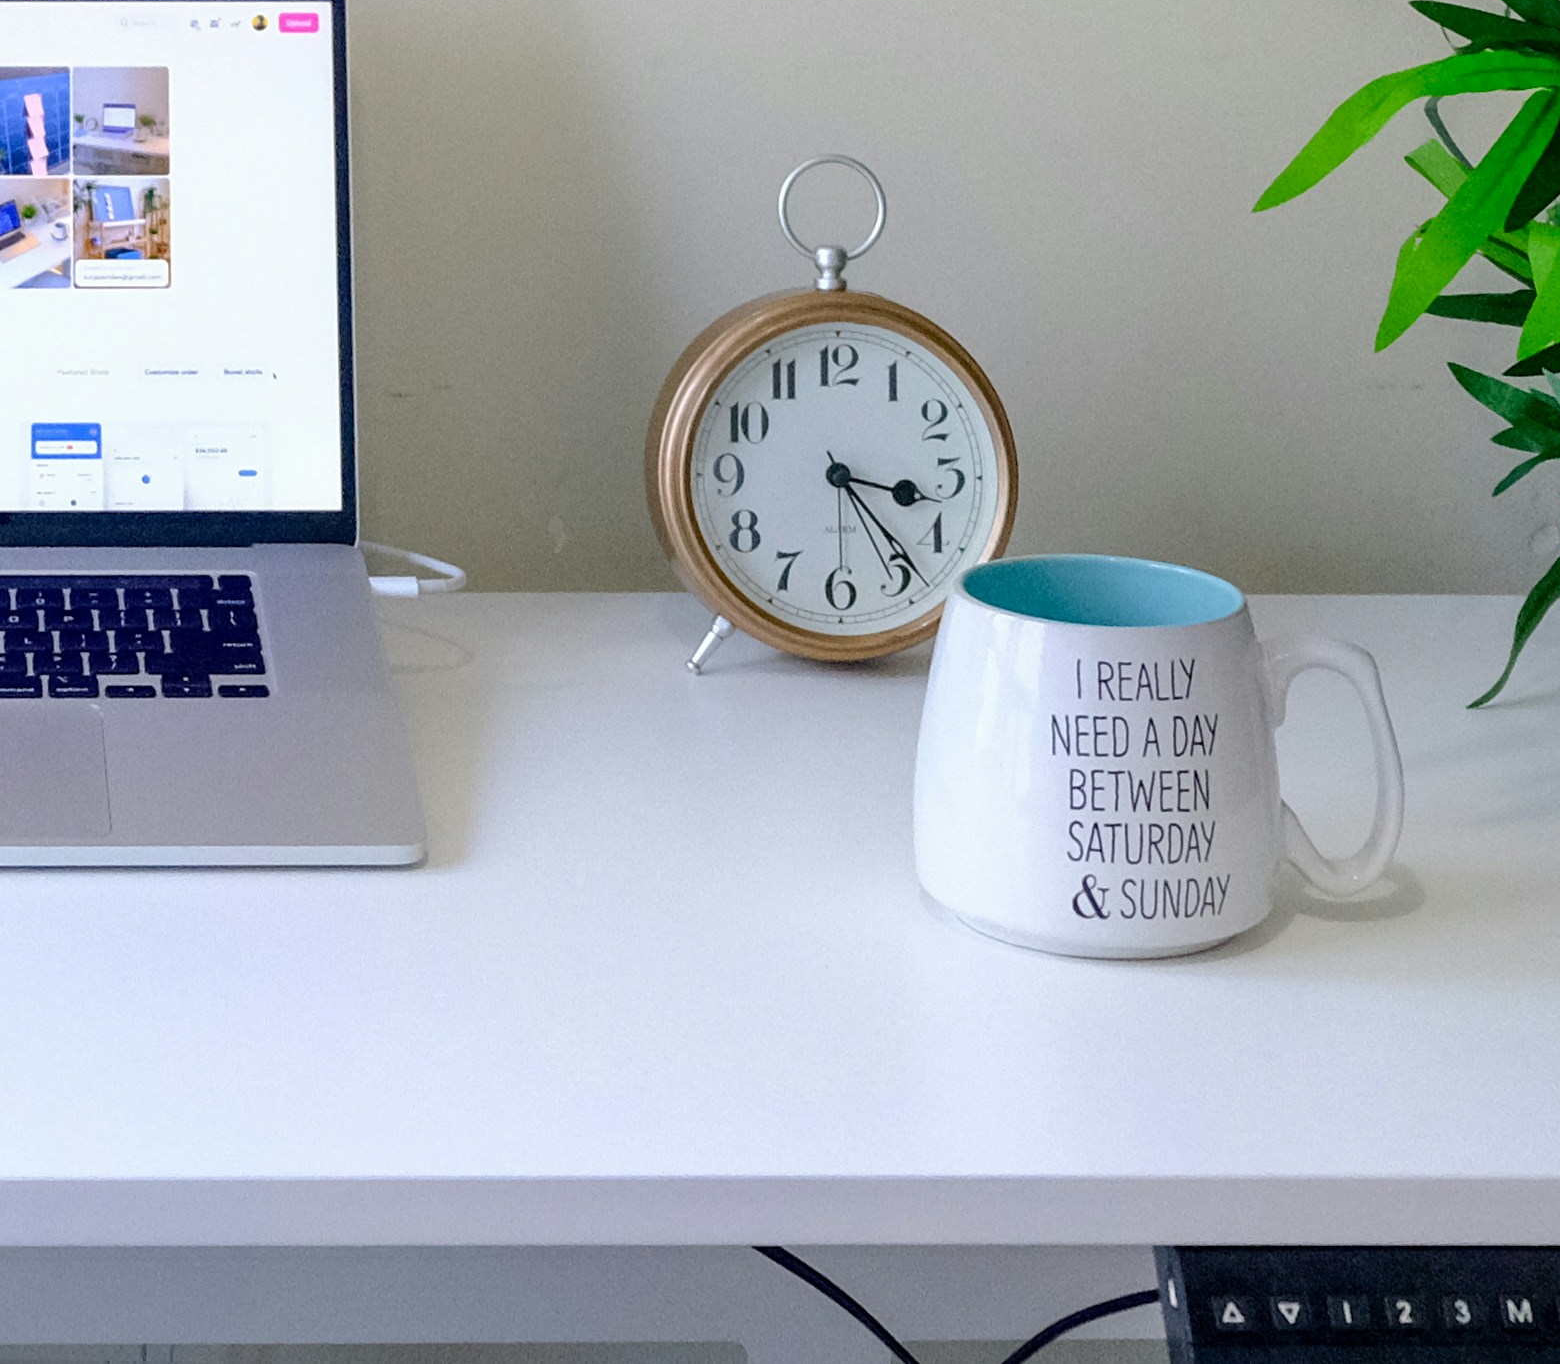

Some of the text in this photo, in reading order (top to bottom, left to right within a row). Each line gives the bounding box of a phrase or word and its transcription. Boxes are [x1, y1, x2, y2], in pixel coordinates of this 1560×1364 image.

[771, 358, 797, 401] 11
[818, 343, 860, 388] 12
[886, 360, 900, 403] 1
[728, 401, 770, 445] 10
[921, 398, 950, 442] 2
[713, 453, 745, 497] 9
[934, 457, 966, 500] 3
[728, 509, 761, 553] 8
[916, 511, 951, 554] 4
[775, 550, 805, 592] 7
[824, 565, 857, 611] 6
[880, 553, 912, 598] 5
[1075, 657, 1196, 701] I REALLY
[1051, 713, 1219, 758] NEED A DAY
[1069, 769, 1210, 812] BETWEEN
[1066, 820, 1217, 865] SATURDAY
[1071, 873, 1231, 920] & SUNDAY
[1342, 1299, 1354, 1324] 1
[1396, 1299, 1413, 1324] 2
[1454, 1299, 1472, 1324] 3
[1505, 1298, 1533, 1324] M
